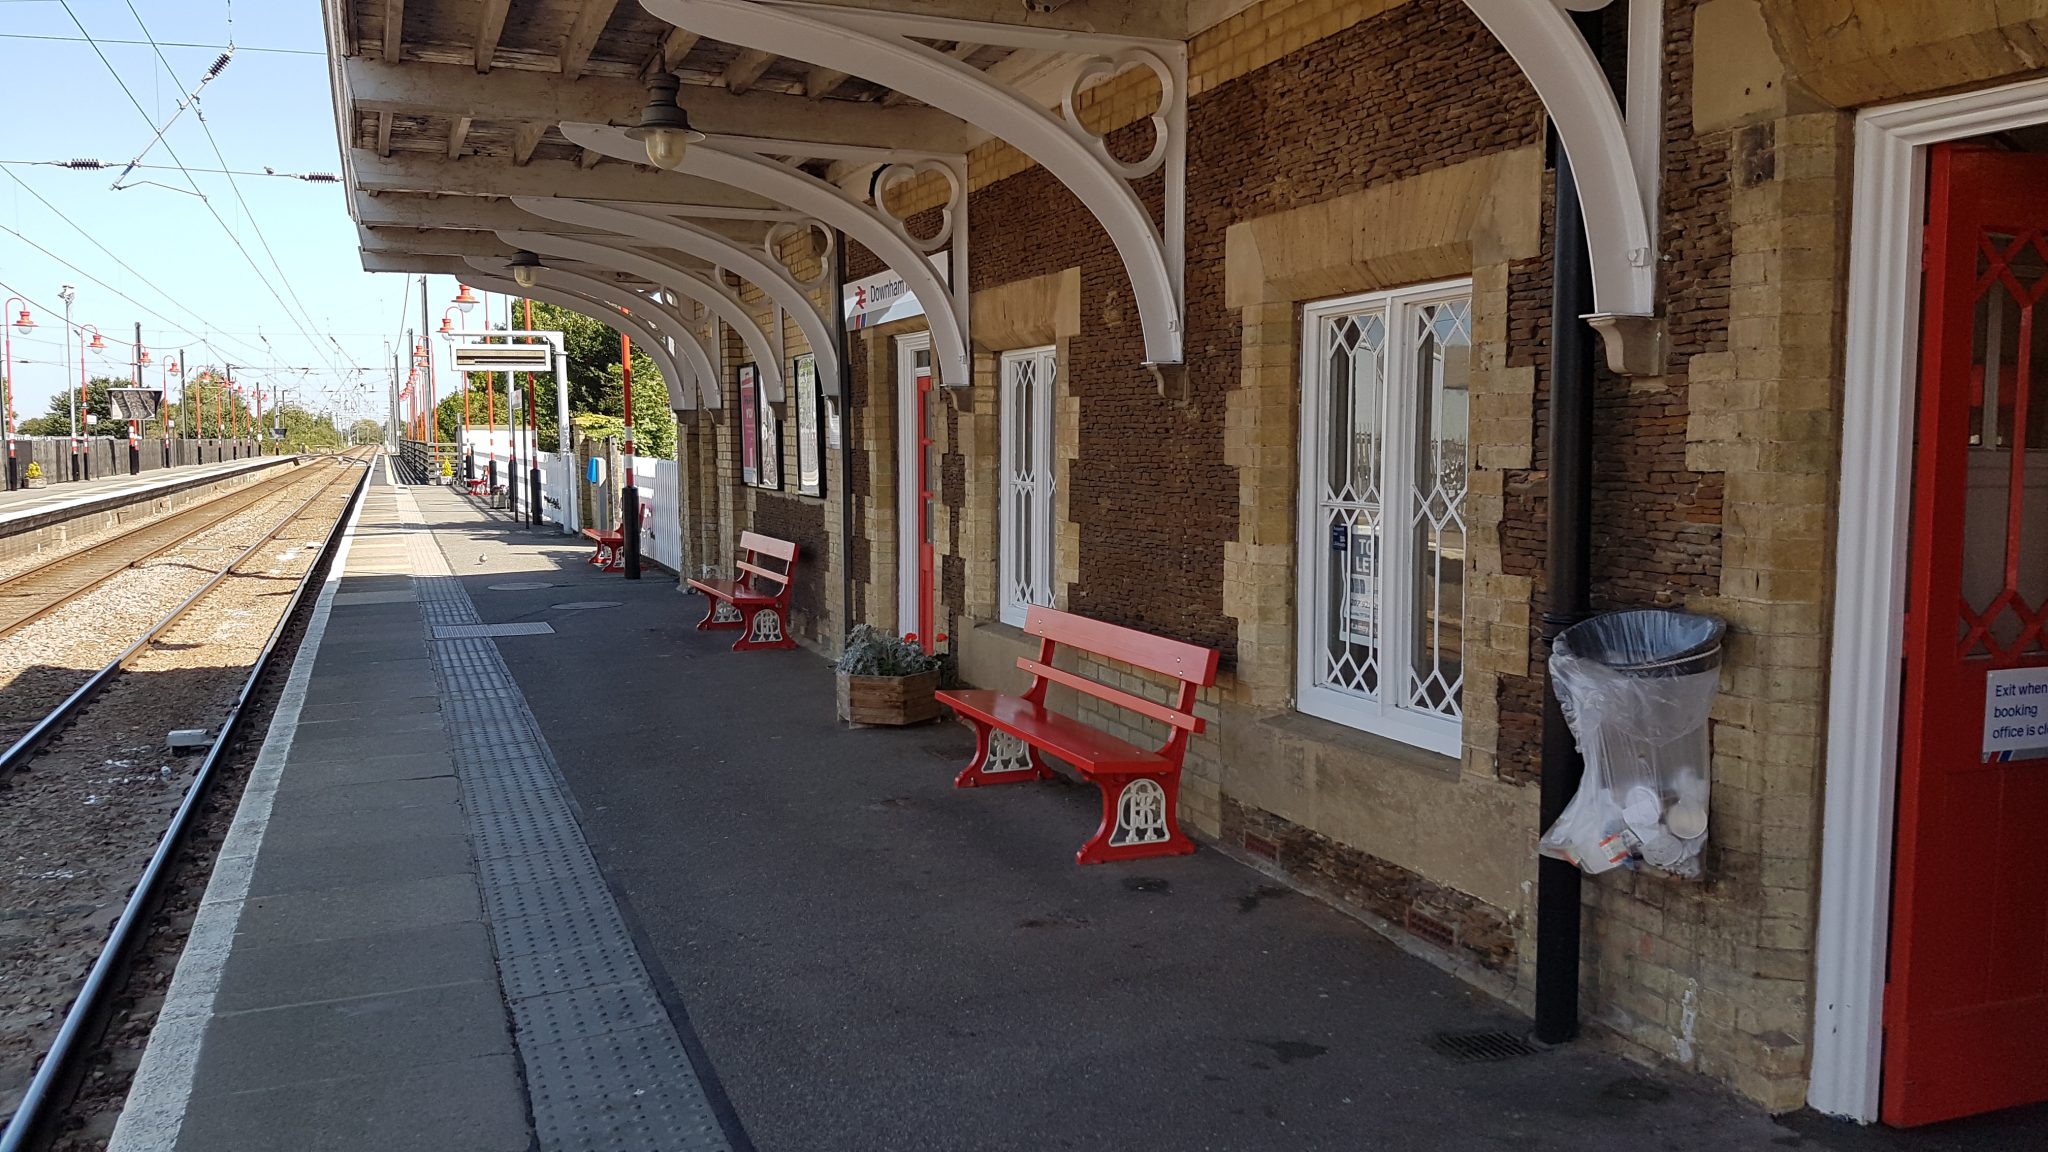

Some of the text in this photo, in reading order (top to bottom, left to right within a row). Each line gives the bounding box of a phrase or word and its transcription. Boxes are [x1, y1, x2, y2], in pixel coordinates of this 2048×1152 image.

[870, 279, 905, 303] Downham
[1995, 682, 2048, 697] Exit when
[1993, 703, 2038, 718] booking
[1992, 725, 2024, 739] office
[2026, 723, 2036, 736] is
